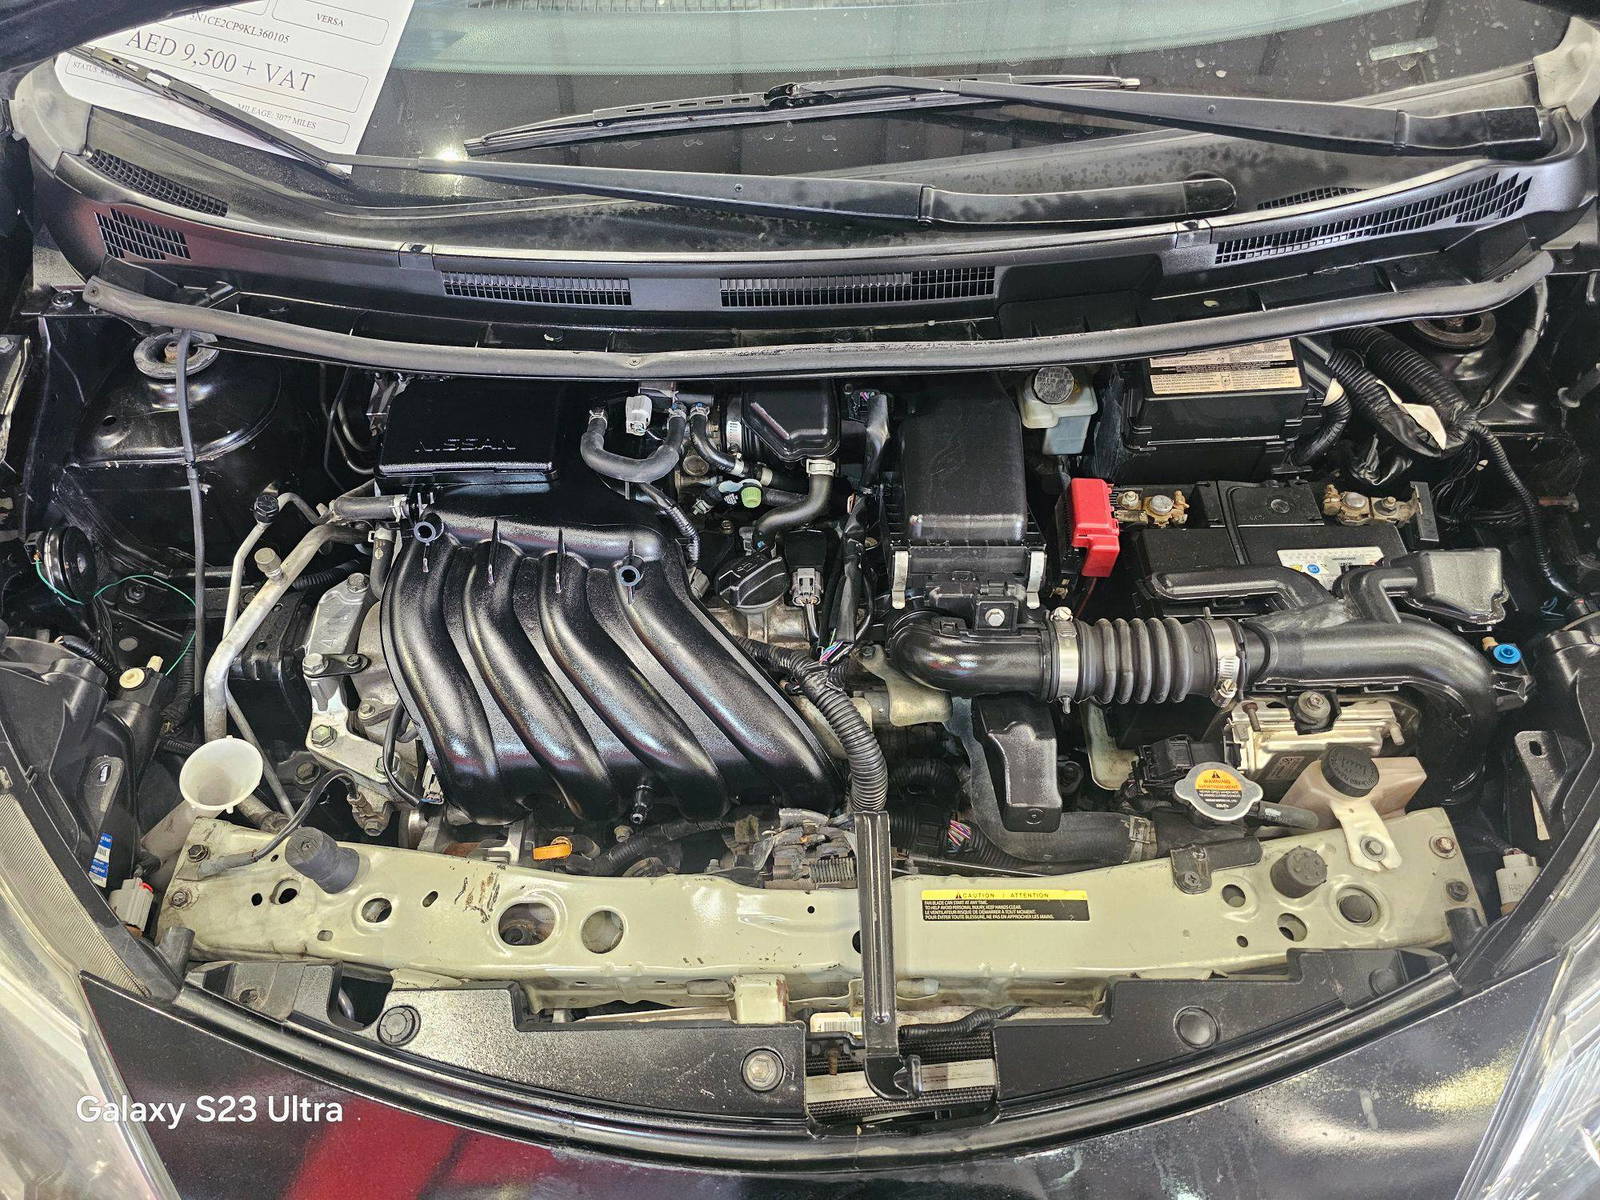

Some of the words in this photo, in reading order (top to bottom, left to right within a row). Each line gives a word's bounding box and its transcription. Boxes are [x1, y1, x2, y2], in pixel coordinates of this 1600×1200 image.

[316, 12, 345, 27] VERSA
[126, 29, 178, 57] AED
[183, 42, 238, 72] 9,500
[242, 61, 257, 76] +
[265, 62, 317, 93] VAT
[292, 117, 318, 129] MILES
